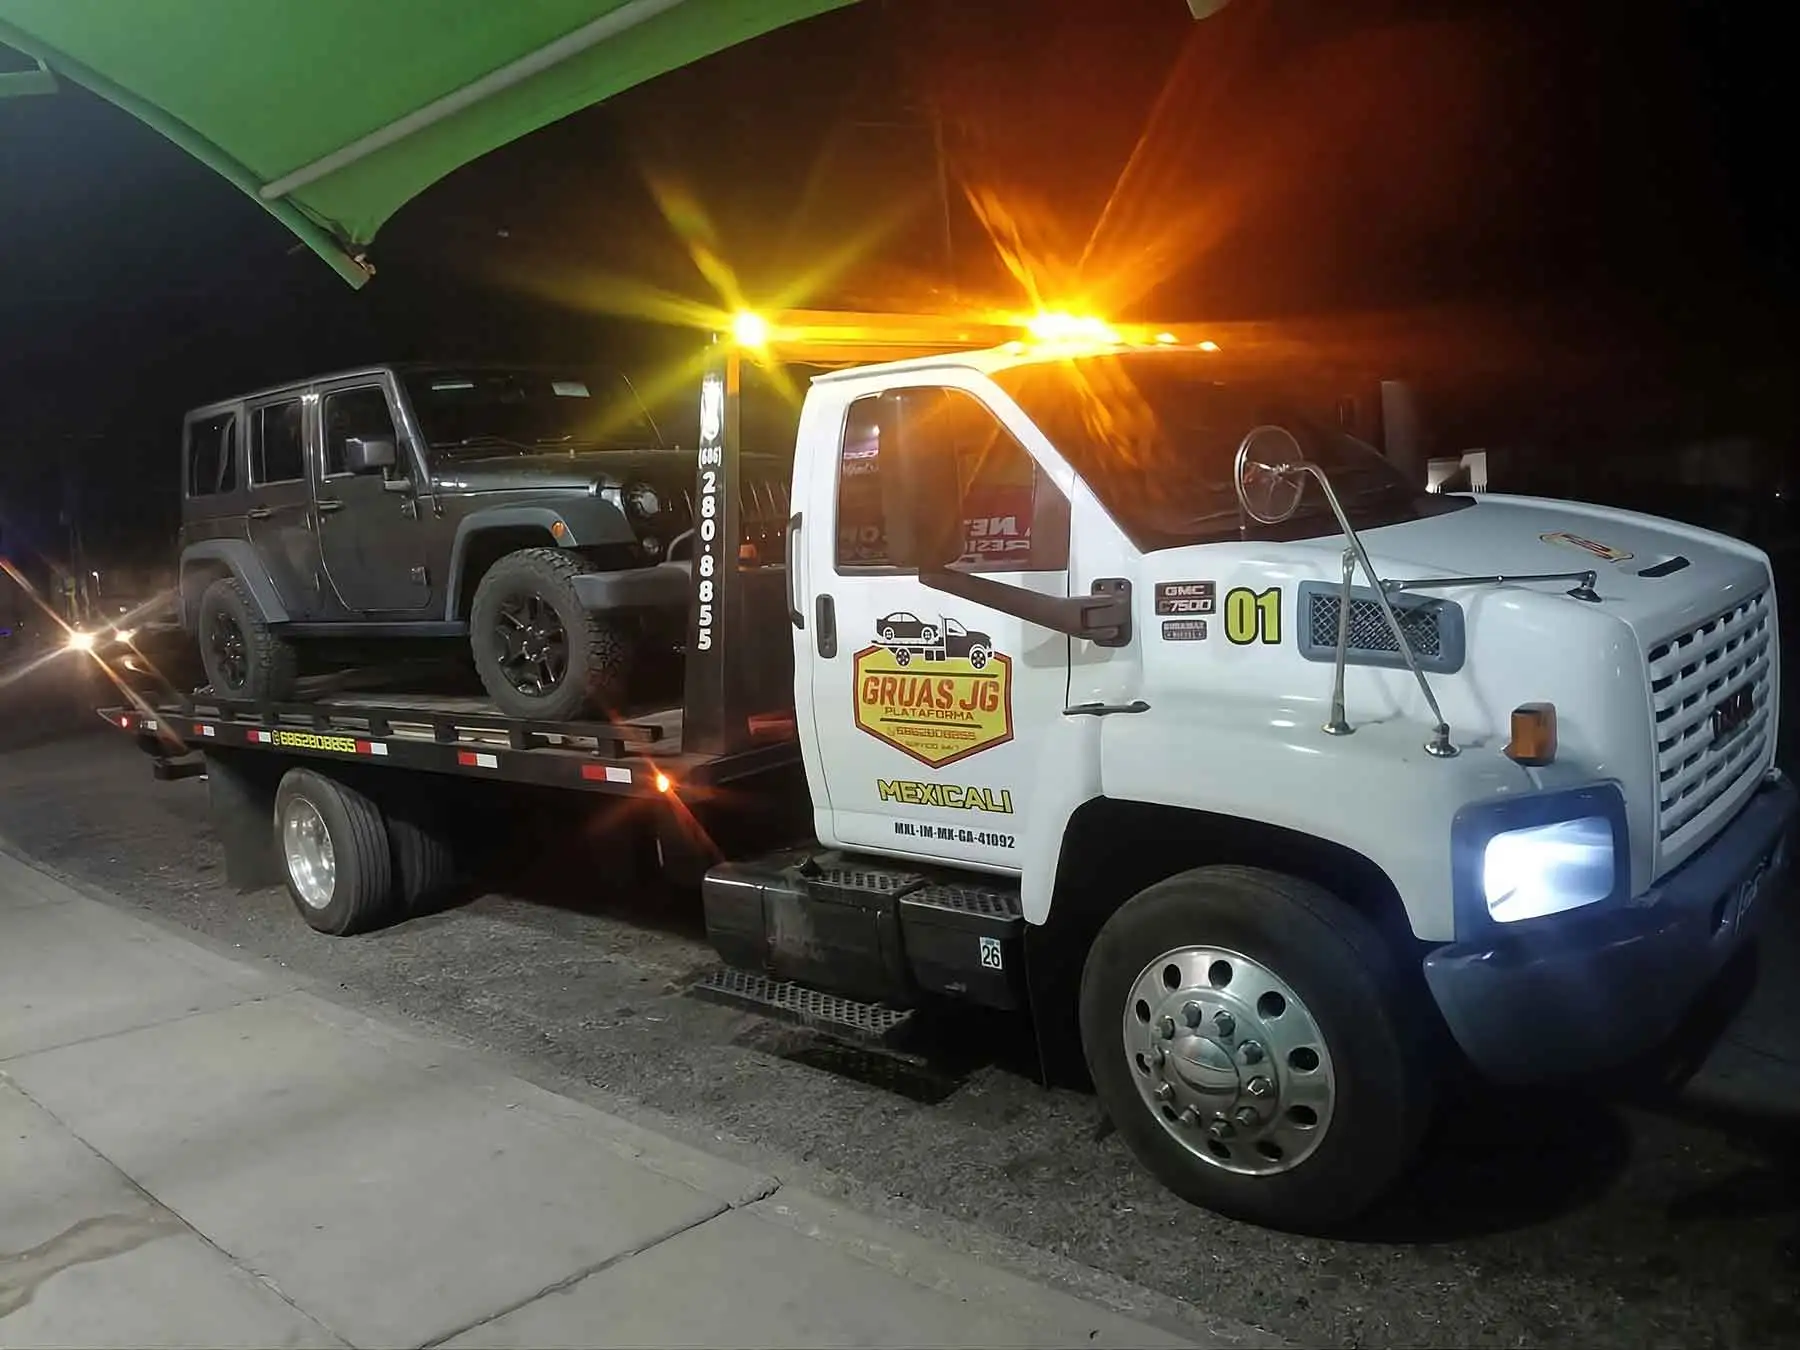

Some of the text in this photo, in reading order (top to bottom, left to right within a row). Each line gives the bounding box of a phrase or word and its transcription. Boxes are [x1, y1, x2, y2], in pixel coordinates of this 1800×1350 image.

[1165, 585, 1205, 596] GMC
[1225, 587, 1282, 645] 01
[863, 676, 1000, 712] GRUAS JG
[884, 707, 974, 721] PLATAFORMA
[877, 779, 1014, 813] MEXICALI
[982, 945, 1000, 967] 26
